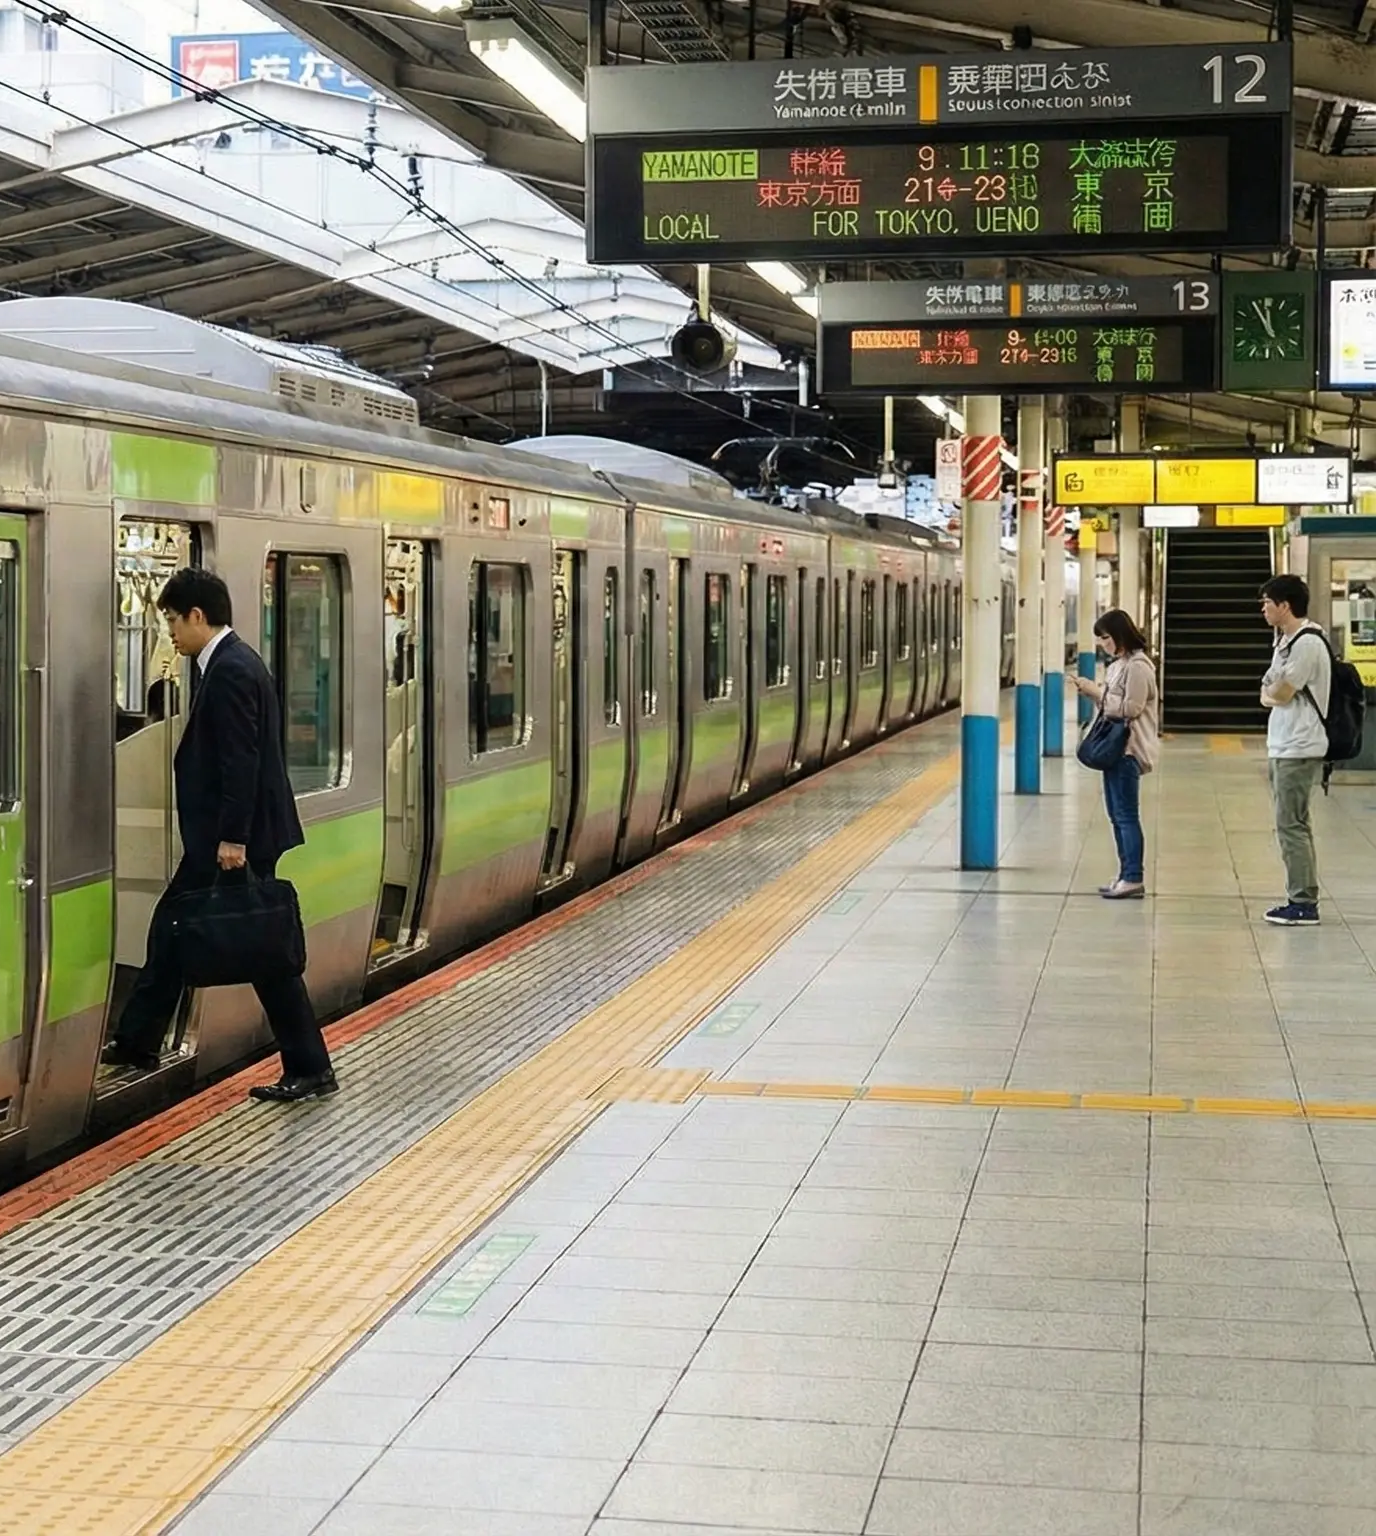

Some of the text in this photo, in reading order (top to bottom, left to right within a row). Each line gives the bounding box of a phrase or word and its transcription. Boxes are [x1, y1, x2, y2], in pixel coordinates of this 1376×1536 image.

[1203, 54, 1267, 104] 12
[644, 151, 755, 179] YAMANOTE
[756, 179, 863, 208] 東京方面
[644, 214, 720, 241] LOCAL
[813, 210, 860, 237] FOR
[976, 206, 1040, 234] UENO
[1172, 281, 1211, 311] 13
